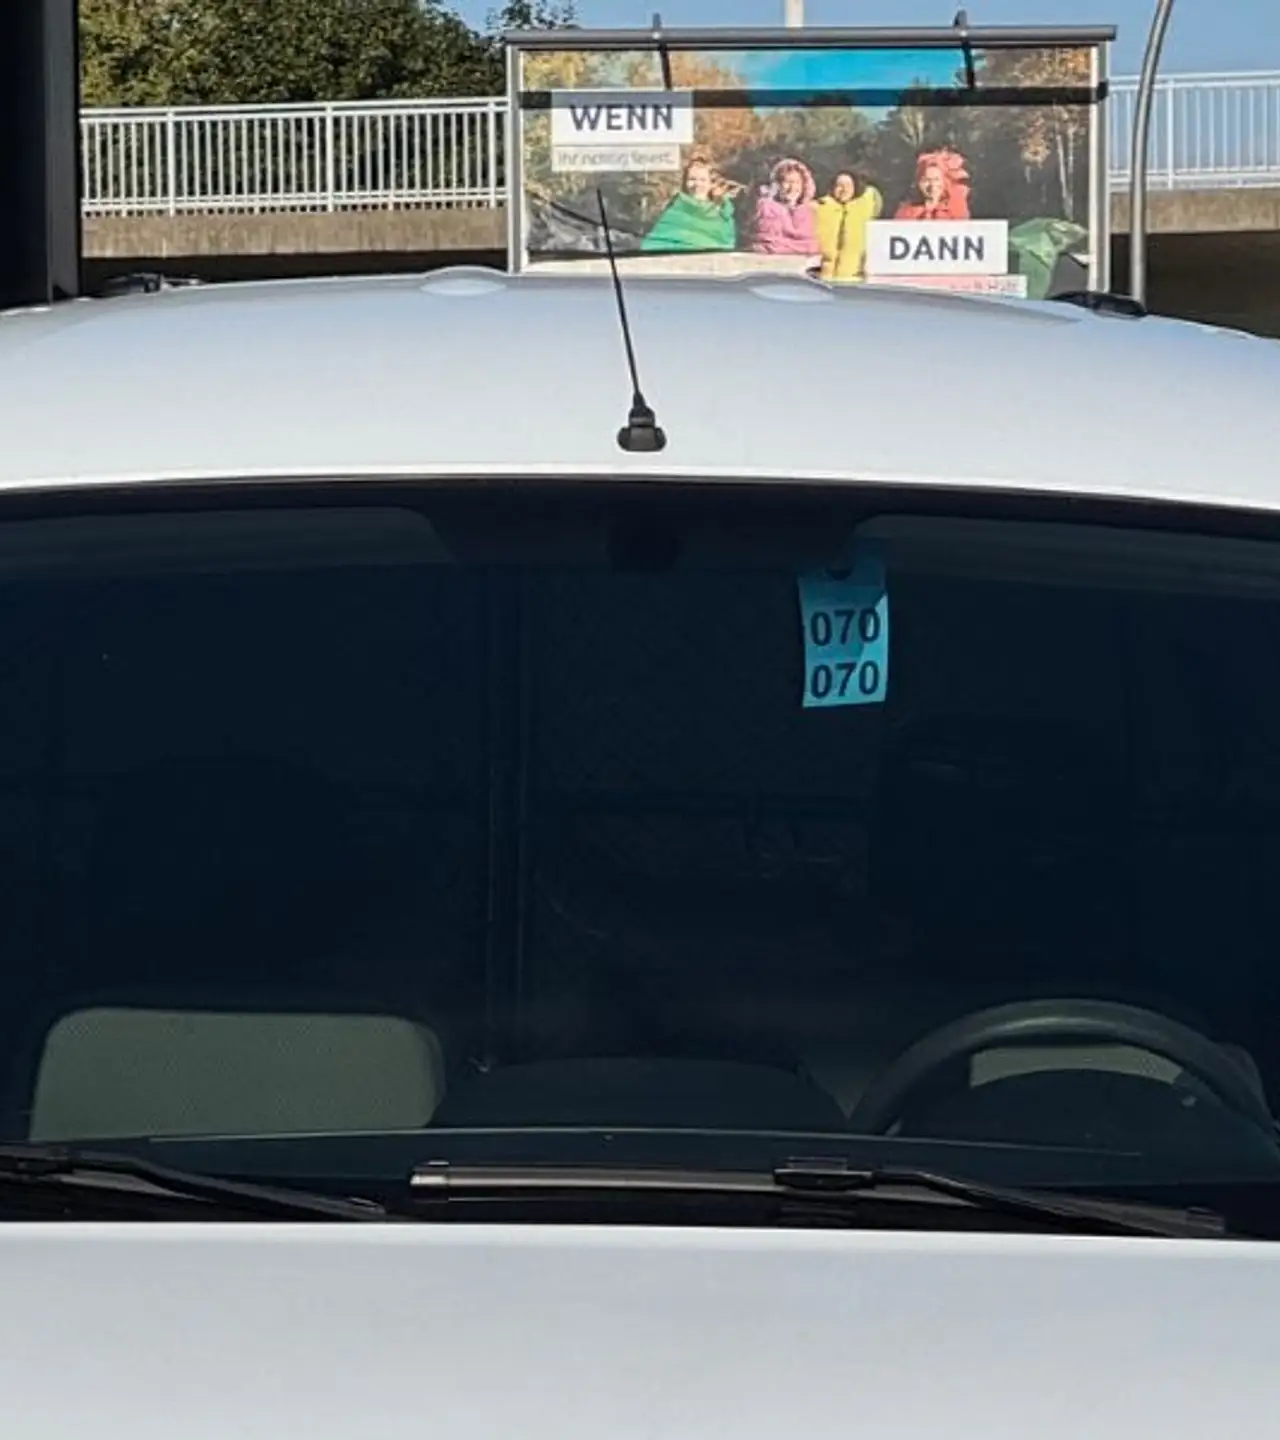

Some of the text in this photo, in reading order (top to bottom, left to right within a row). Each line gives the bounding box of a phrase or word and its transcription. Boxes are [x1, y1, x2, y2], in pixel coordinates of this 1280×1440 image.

[570, 104, 673, 131] WENN
[889, 235, 985, 261] DANN
[811, 609, 880, 646] 070
[811, 660, 879, 698] 070
